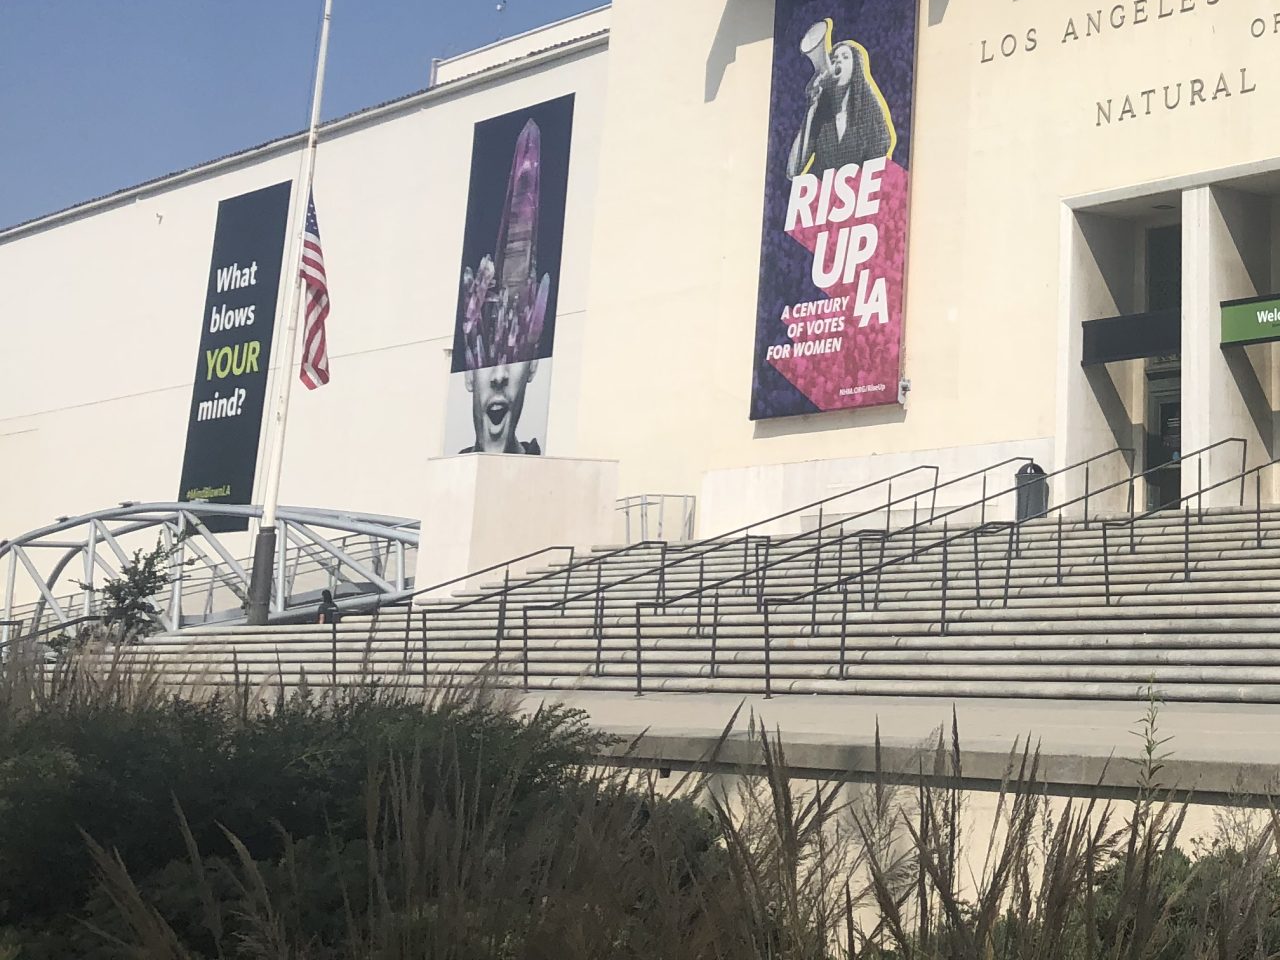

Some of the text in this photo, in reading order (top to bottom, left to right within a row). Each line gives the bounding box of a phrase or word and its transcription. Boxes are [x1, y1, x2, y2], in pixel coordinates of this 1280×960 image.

[980, 27, 1038, 64] LOS
[1095, 67, 1257, 127] NATURAL
[783, 155, 887, 232] RISE
[811, 223, 879, 289] UP
[216, 261, 258, 293] What
[780, 296, 850, 320] A CENTURY
[853, 268, 889, 328] LA
[209, 303, 256, 333] blows
[787, 316, 846, 339] OF VOTES
[206, 340, 261, 381] YOUR
[766, 336, 842, 361] FOR WOMEN
[197, 387, 246, 422] mind?
